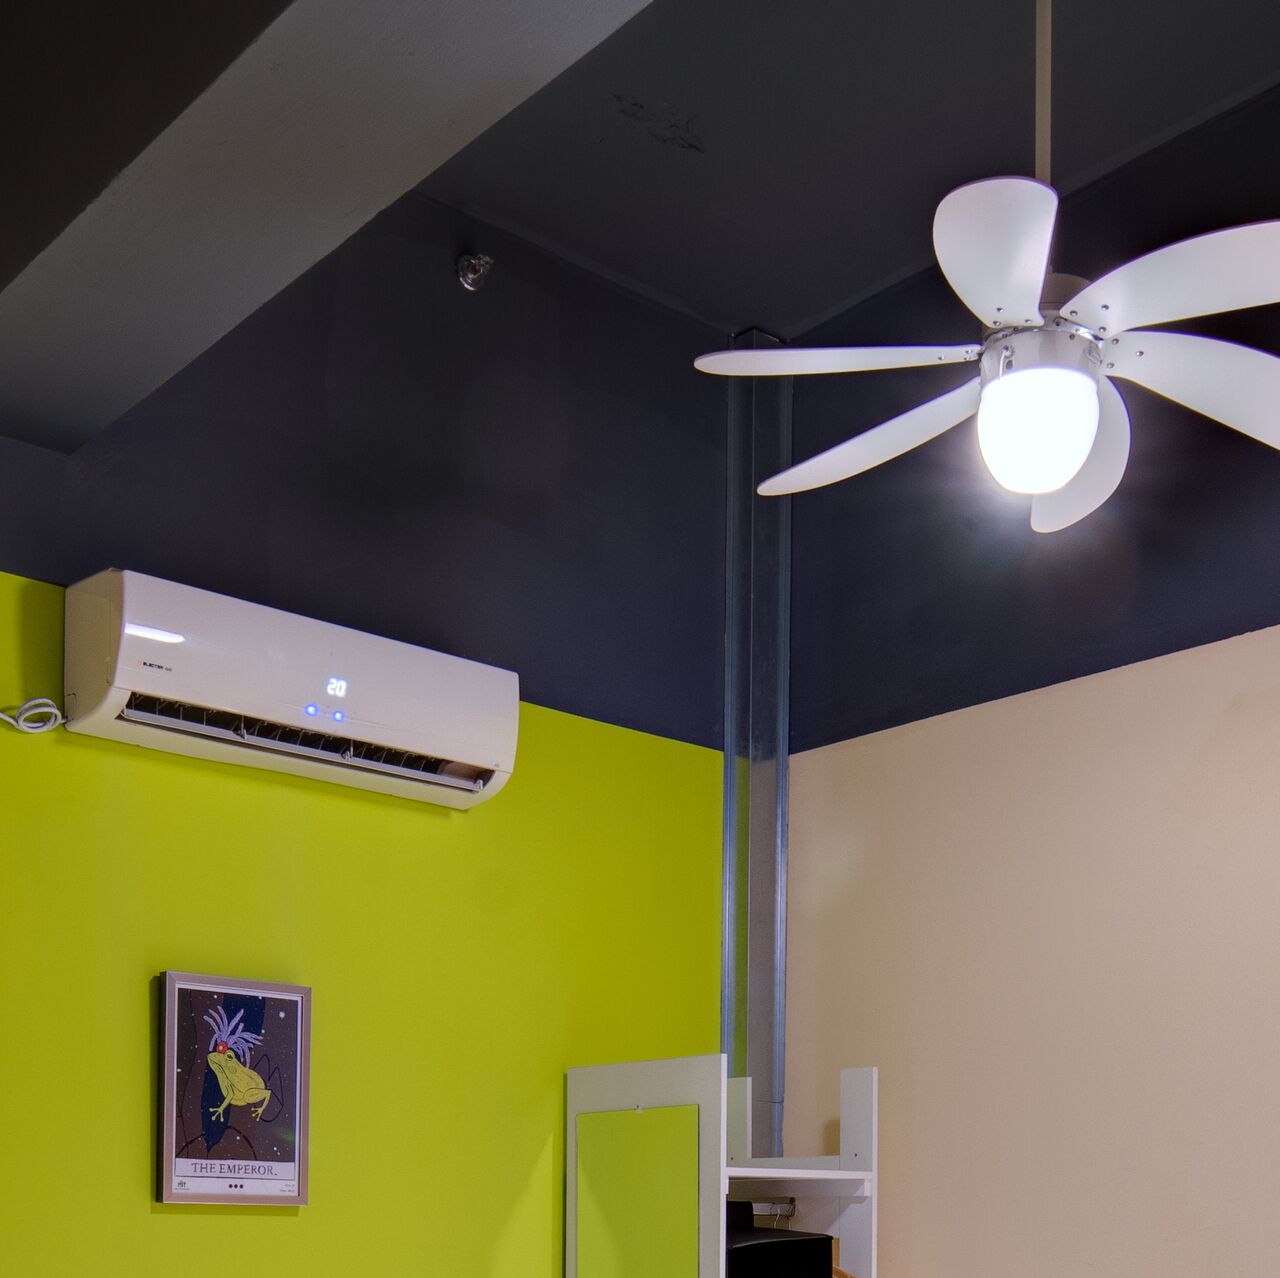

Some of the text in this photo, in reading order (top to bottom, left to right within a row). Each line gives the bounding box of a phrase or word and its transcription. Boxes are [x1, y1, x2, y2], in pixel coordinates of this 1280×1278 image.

[327, 677, 347, 697] 20
[191, 1162, 278, 1176] THE EMPEROR.
